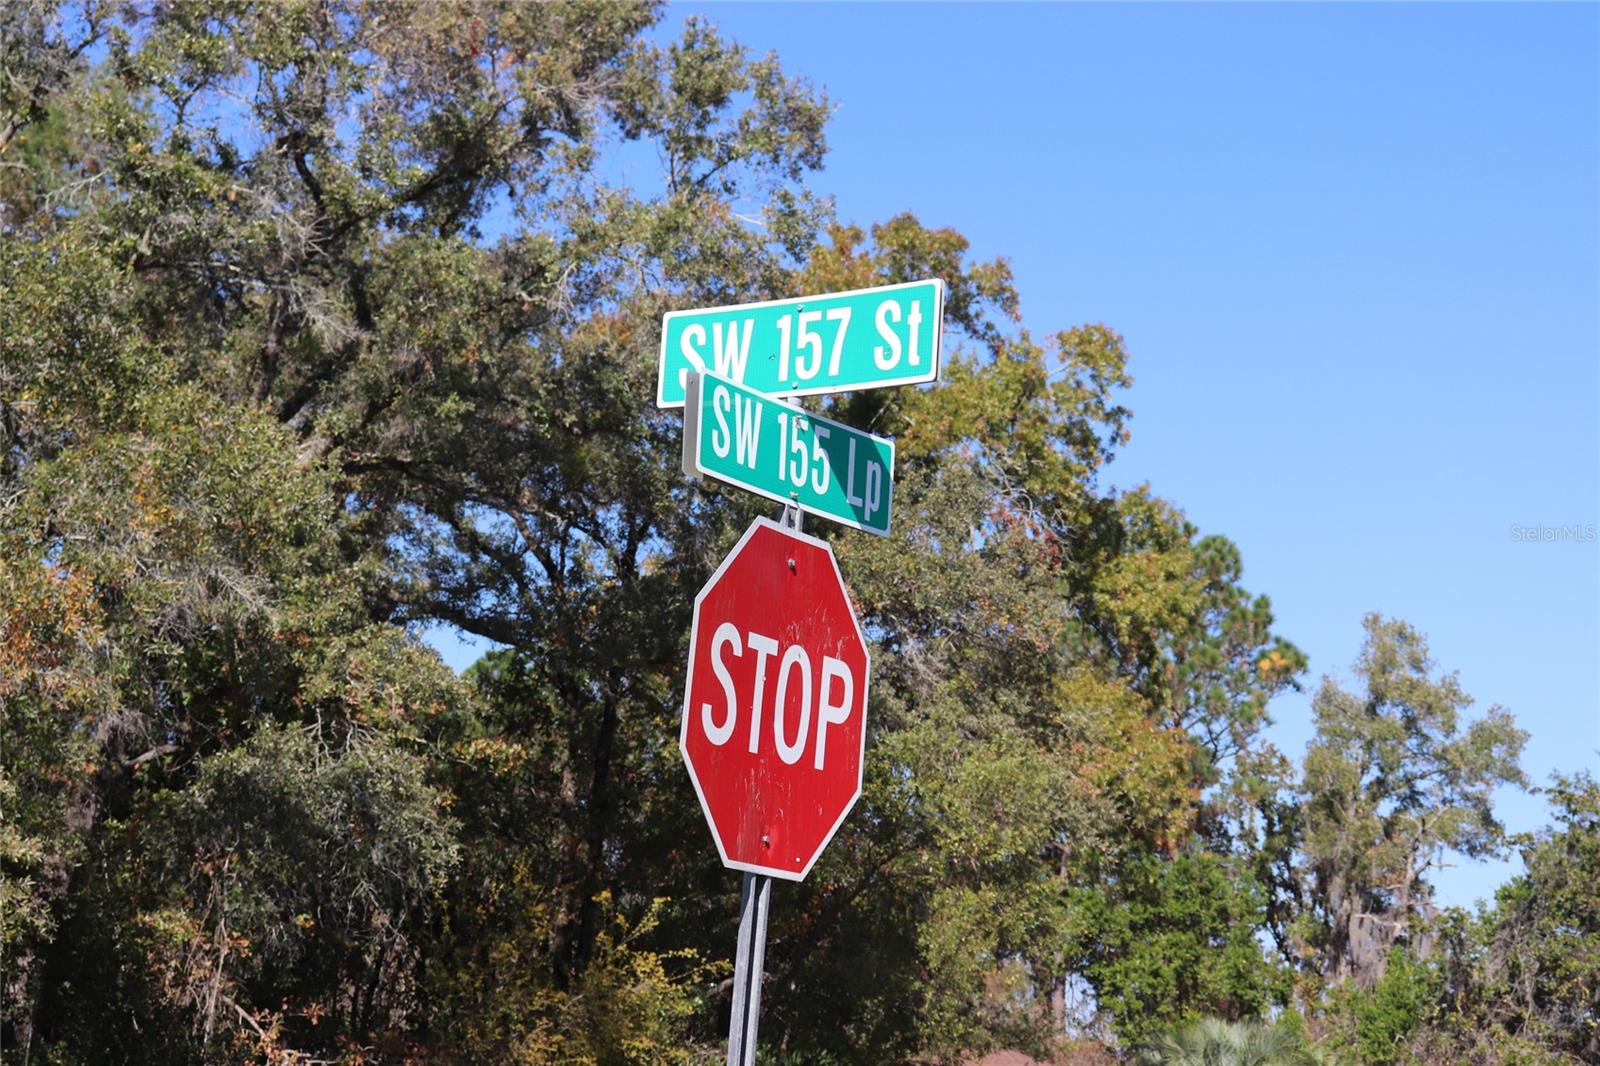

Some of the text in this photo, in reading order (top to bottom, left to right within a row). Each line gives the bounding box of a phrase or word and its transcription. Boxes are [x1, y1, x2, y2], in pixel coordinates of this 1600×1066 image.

[679, 299, 922, 391] SW 157 St
[712, 385, 882, 521] SW 155 Lp
[702, 622, 854, 770] STOP
